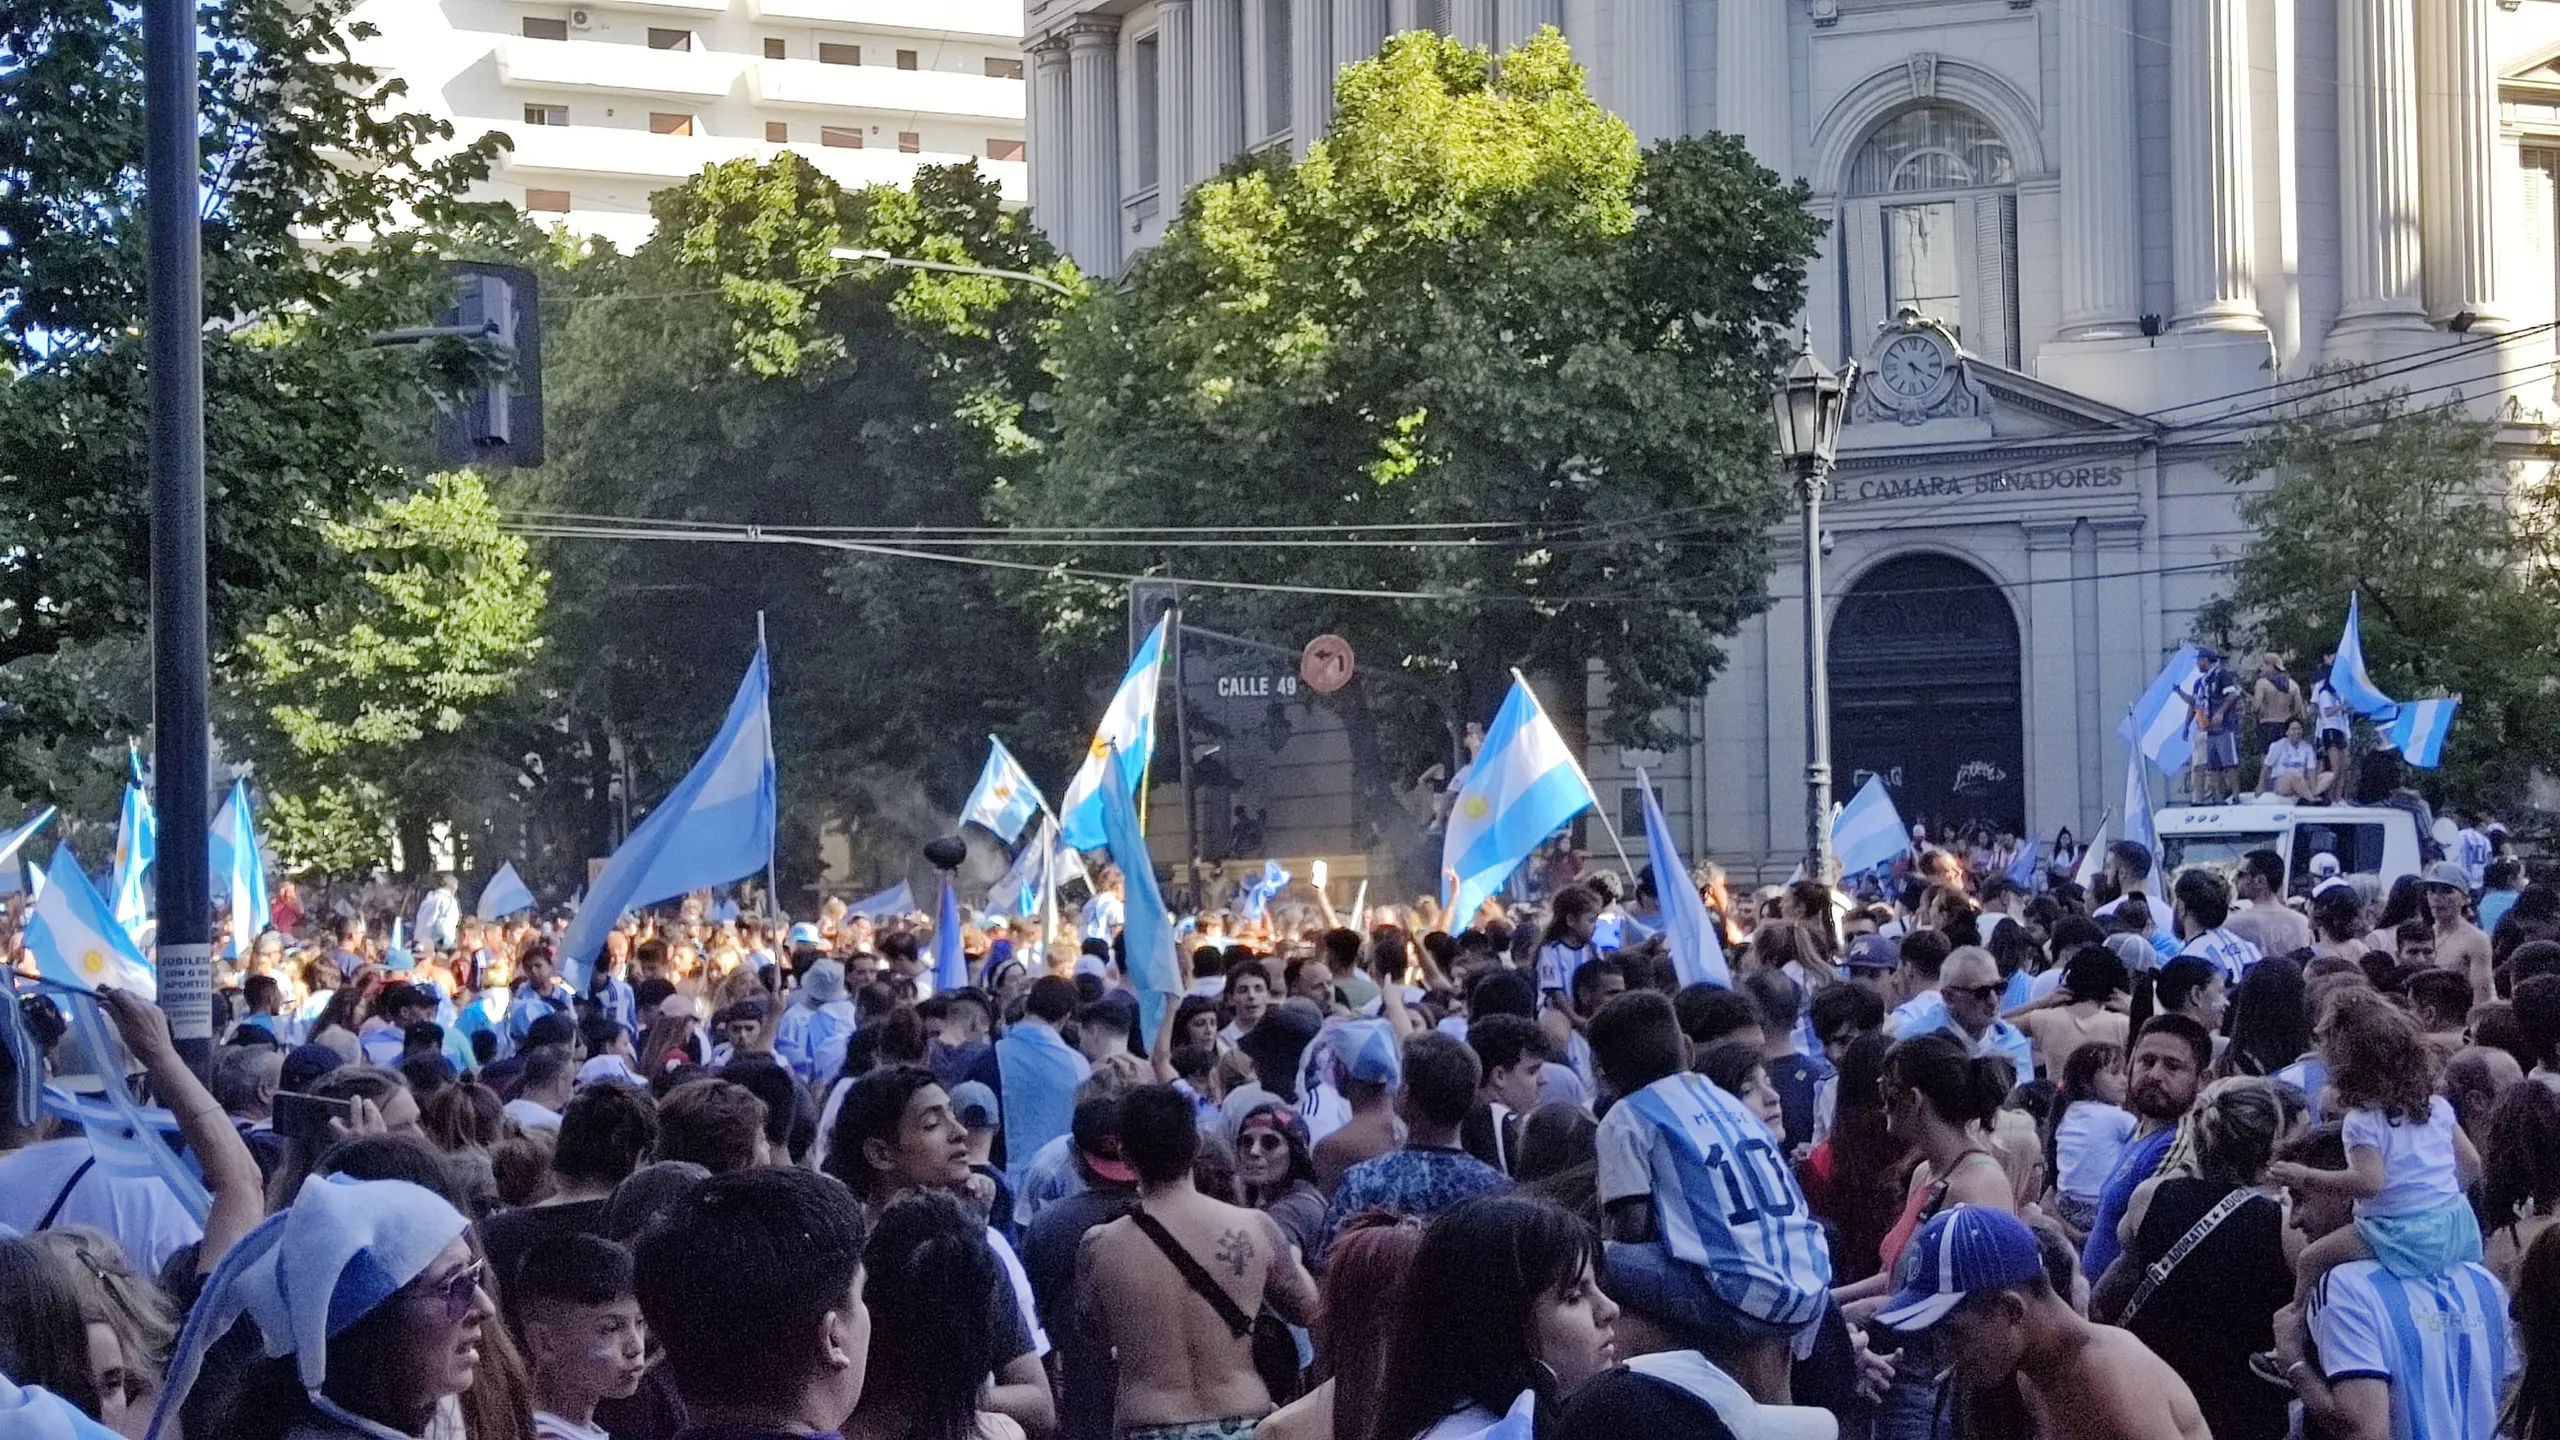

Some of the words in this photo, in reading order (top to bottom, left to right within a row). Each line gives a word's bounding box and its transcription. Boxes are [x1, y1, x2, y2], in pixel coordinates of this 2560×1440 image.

[1858, 476, 1963, 501] CAMARA
[1974, 466, 2124, 495] SENADORES
[1217, 676, 1269, 697] CALLE
[1276, 676, 1297, 696] 49
[1703, 1138, 1796, 1227] 10
[2167, 1218, 2214, 1264] ADORATTA
